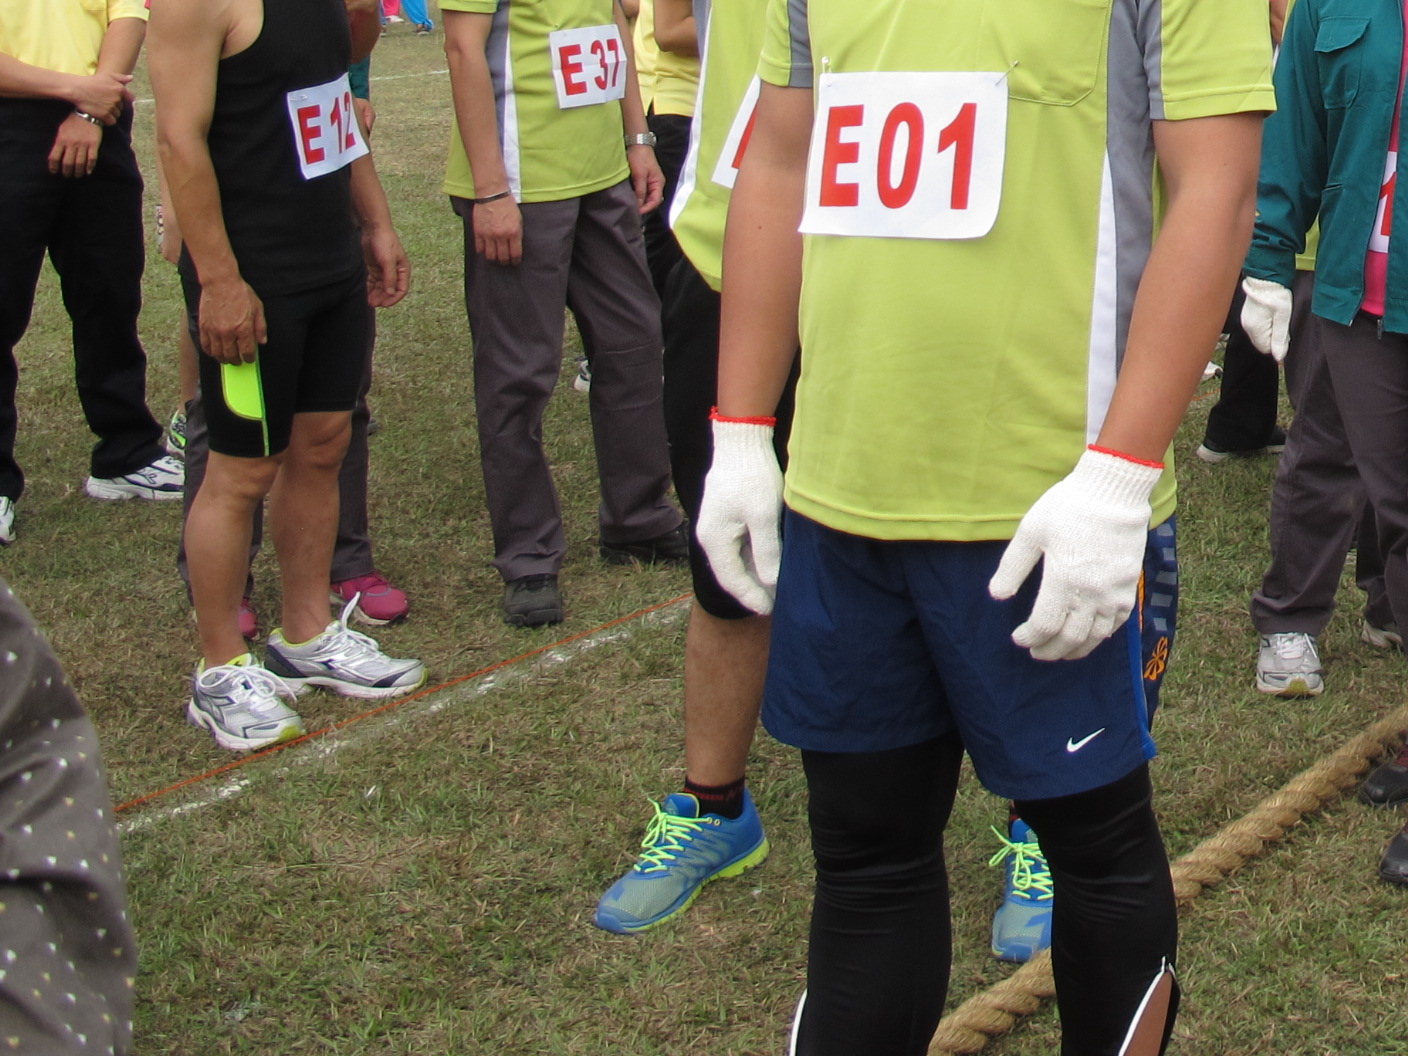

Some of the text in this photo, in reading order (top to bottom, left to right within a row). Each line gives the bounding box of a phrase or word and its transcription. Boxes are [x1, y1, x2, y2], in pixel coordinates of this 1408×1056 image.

[558, 38, 620, 96] E37
[297, 91, 357, 164] E12
[819, 102, 977, 210] E01
